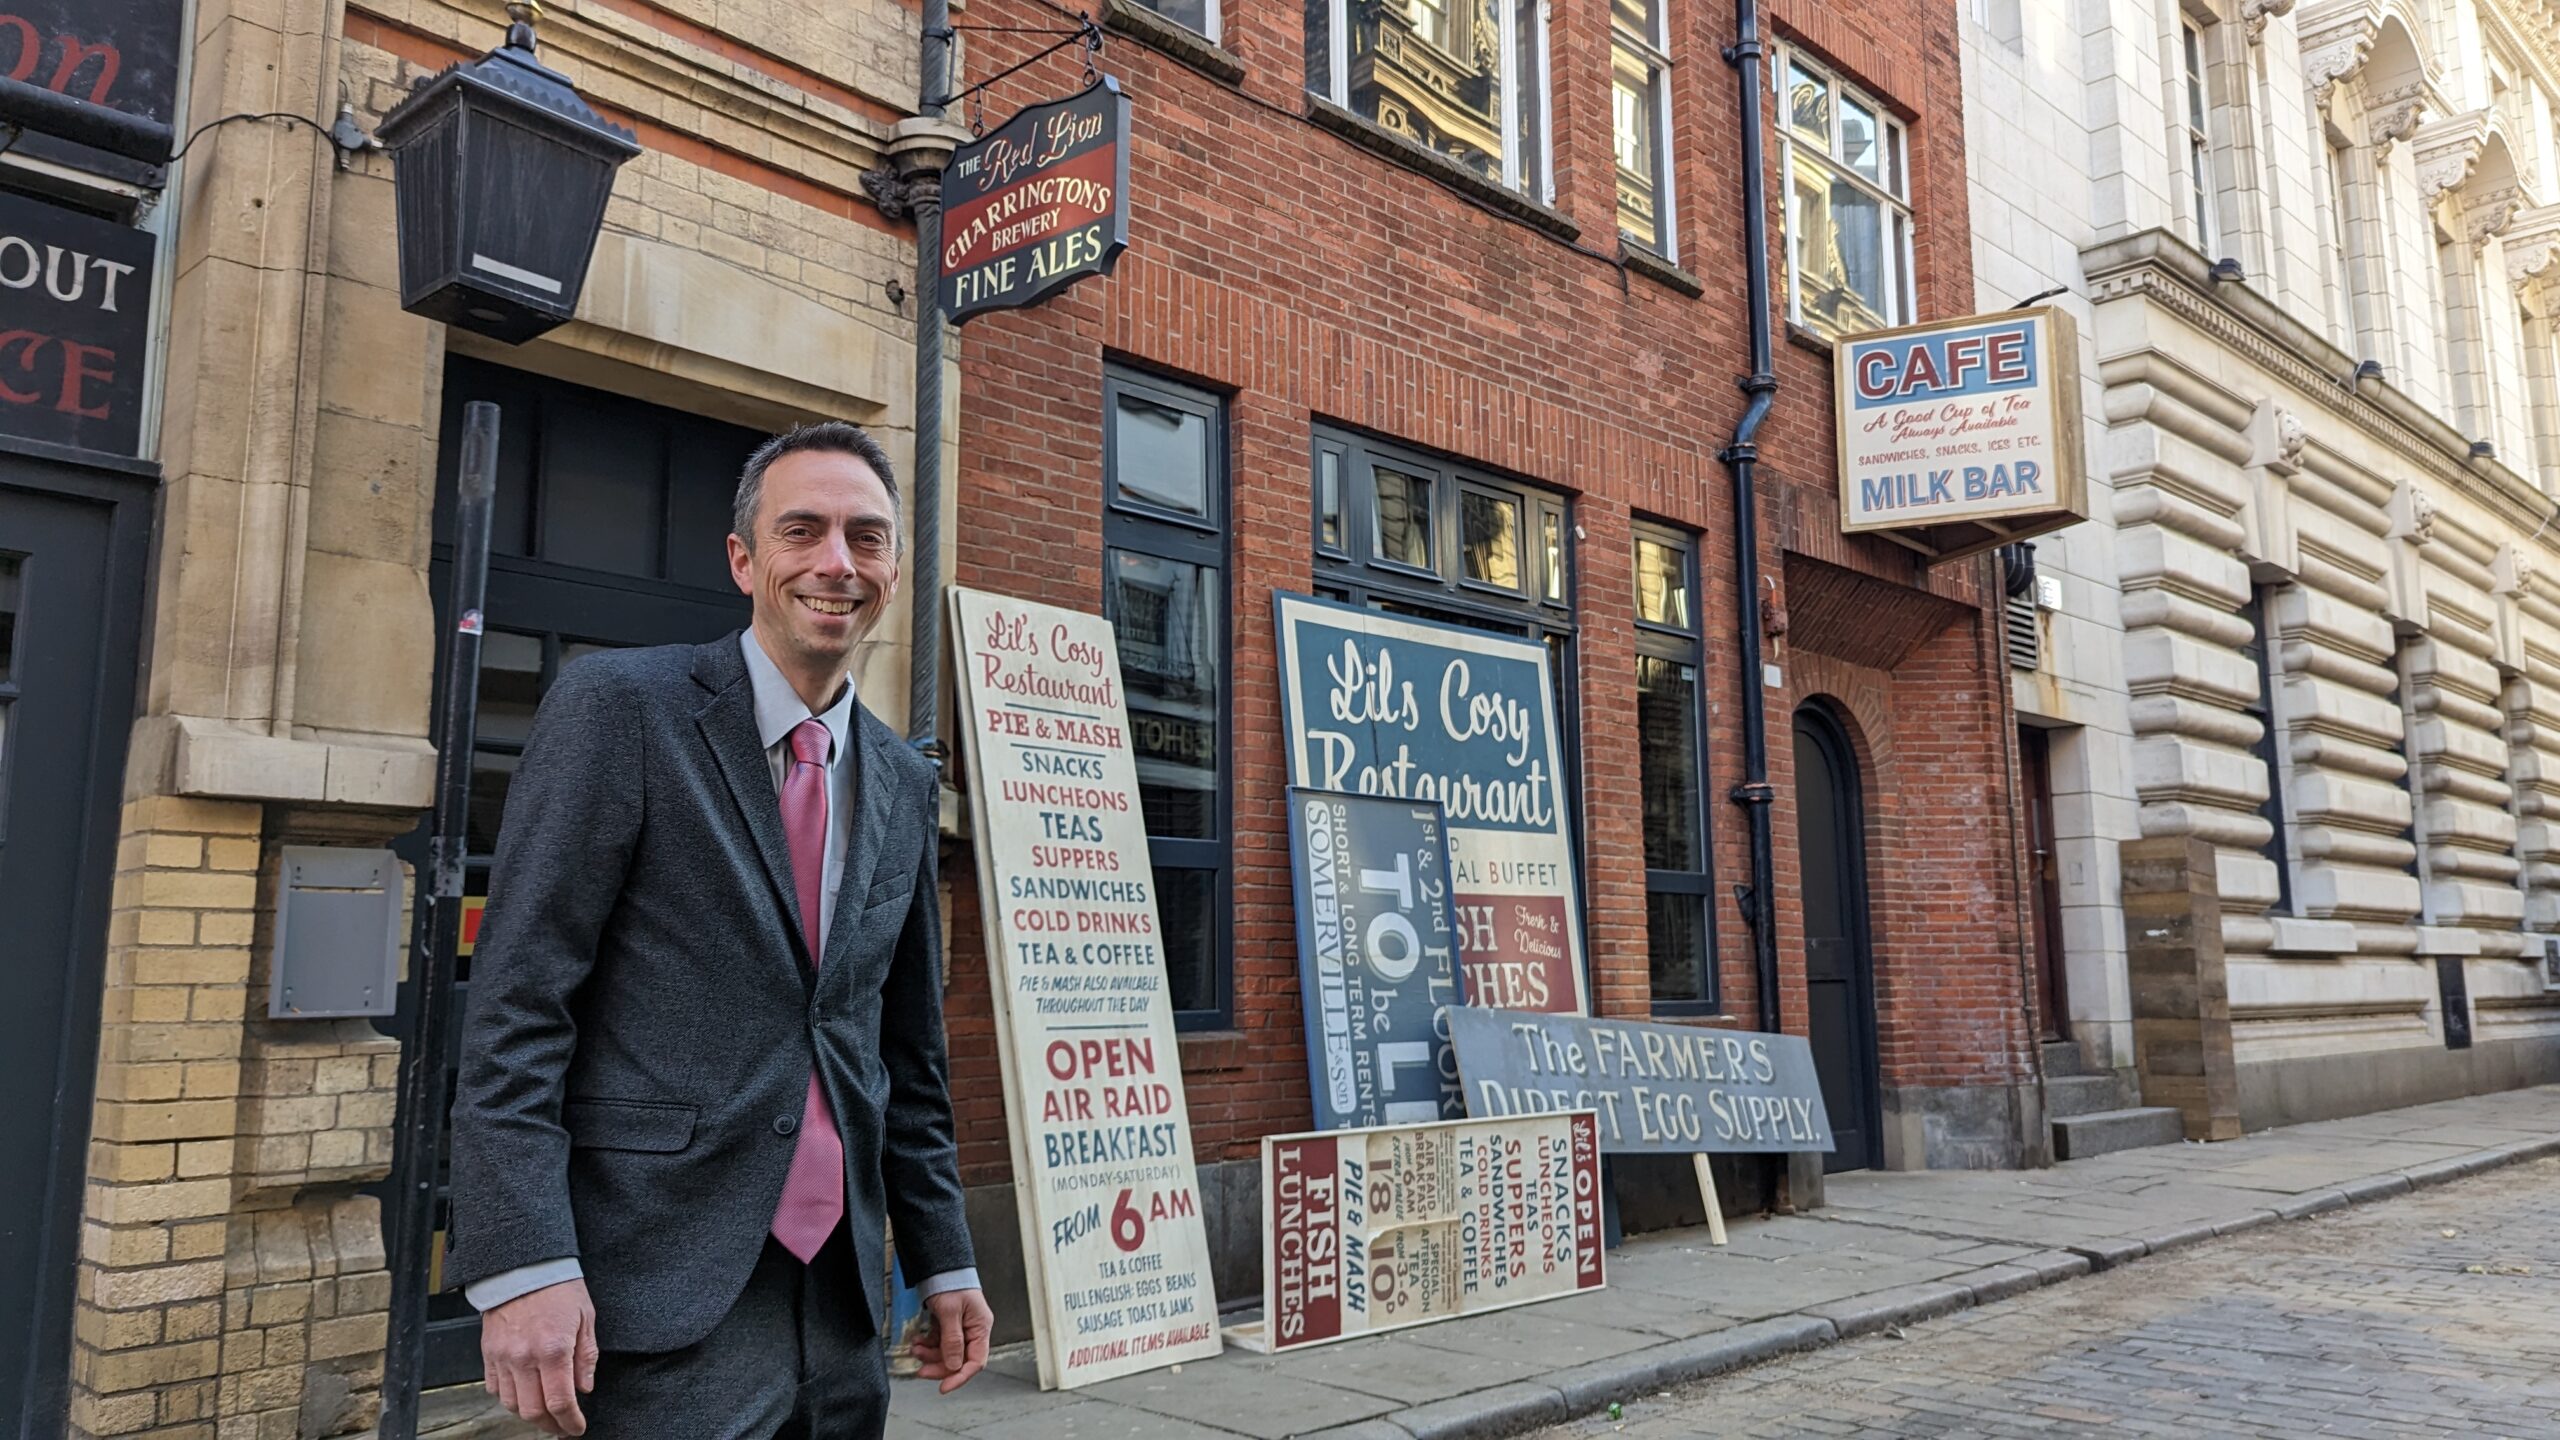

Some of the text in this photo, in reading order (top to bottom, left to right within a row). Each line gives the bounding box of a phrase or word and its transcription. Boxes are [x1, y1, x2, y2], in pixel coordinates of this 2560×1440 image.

[958, 111, 1102, 191] THE Red Lion
[945, 176, 1111, 269] CHARRINGTON'S
[992, 207, 1061, 252] BREWERY
[955, 225, 1102, 308] FINE ALES
[1855, 329, 2029, 401] CAFE
[1863, 394, 2031, 433] A Good Cup of Tea
[1890, 416, 2018, 443] Always Available
[1988, 439, 2011, 452] ICES
[2018, 436, 2041, 448] ETC.
[1861, 460, 2042, 512] MILK BAR
[985, 611, 1103, 678] Lil's Cosy
[975, 652, 1117, 709] Restaurant
[987, 709, 1030, 737] PIE
[1035, 718, 1051, 739] &
[1055, 719, 1123, 749] MASH
[1440, 659, 1530, 767] Cosy
[1023, 751, 1103, 780] SNACKS
[1002, 780, 1128, 812] LUNCHEONS
[1040, 812, 1103, 842] TEAS
[1032, 846, 1120, 871] SUPPERS
[1417, 848, 1433, 871] &
[1489, 861, 1558, 886] BUFFET
[1010, 876, 1146, 903] SANDWICHES
[1418, 878, 1451, 933] 2nd
[1014, 909, 1152, 934] COLD DRINKS
[1358, 853, 1420, 983] TO
[1514, 903, 1548, 932] Fresh
[1550, 916, 1560, 934] &
[1018, 942, 1155, 965] TEA & COFFEE
[1333, 804, 1377, 1128] SHORT & LONG TERM RENTS
[1513, 929, 1562, 960] Delicious
[1019, 975, 1159, 991] PIE & MASH ALSO AVAILABLE
[1036, 996, 1150, 1013] THROUGHOUT THE DAY
[1371, 988, 1398, 1034] be
[1424, 944, 1465, 1115] FLOOR
[1046, 1037, 1155, 1081] OPEN
[1511, 1021, 1777, 1084] The FARMERS
[1043, 1083, 1172, 1123] AIR RAID
[1631, 1086, 1703, 1143] EGG
[1708, 1089, 1823, 1144] SUPPLY.
[1044, 1123, 1177, 1169] BREAKFAST
[1404, 1143, 1412, 1165] FROM
[1392, 1136, 1404, 1220] EXTRA VALUE
[1415, 1132, 1427, 1221] BREAKFAST
[1425, 1139, 1436, 1211] AIR RAID
[1552, 1138, 1572, 1263] SNACKS
[1572, 1119, 1596, 1274] Lil's OPEN
[1052, 1188, 1195, 1254] FROM 6 AM
[1460, 1136, 1478, 1295] TEA & COFFEE
[1477, 1145, 1492, 1280] COLD DRINKS
[1490, 1135, 1507, 1288] SANDWICHES
[1505, 1140, 1526, 1278] SUPPERS
[1526, 1180, 1539, 1232] TEAS
[1538, 1135, 1555, 1274] LUNCHEONS
[1279, 1146, 1304, 1340] LUNCHES
[1306, 1172, 1337, 1304] FISH
[1344, 1159, 1366, 1314] PIE & MASH
[1396, 1231, 1405, 1259] FROM
[1064, 1291, 1087, 1311] FULL
[1136, 1278, 1162, 1298] EGGS
[1166, 1272, 1197, 1292] BEANS
[1099, 1253, 1163, 1279] TEA & COFFEE
[1409, 1251, 1420, 1287] TEA
[1421, 1228, 1431, 1313] AFTERNOON
[1431, 1243, 1440, 1295] SPECIAL
[1077, 1296, 1194, 1334] SAUSAGE TOAST & JAMS
[1067, 1322, 1210, 1369] ADDITIONAL ITEMS AVAILABLE
